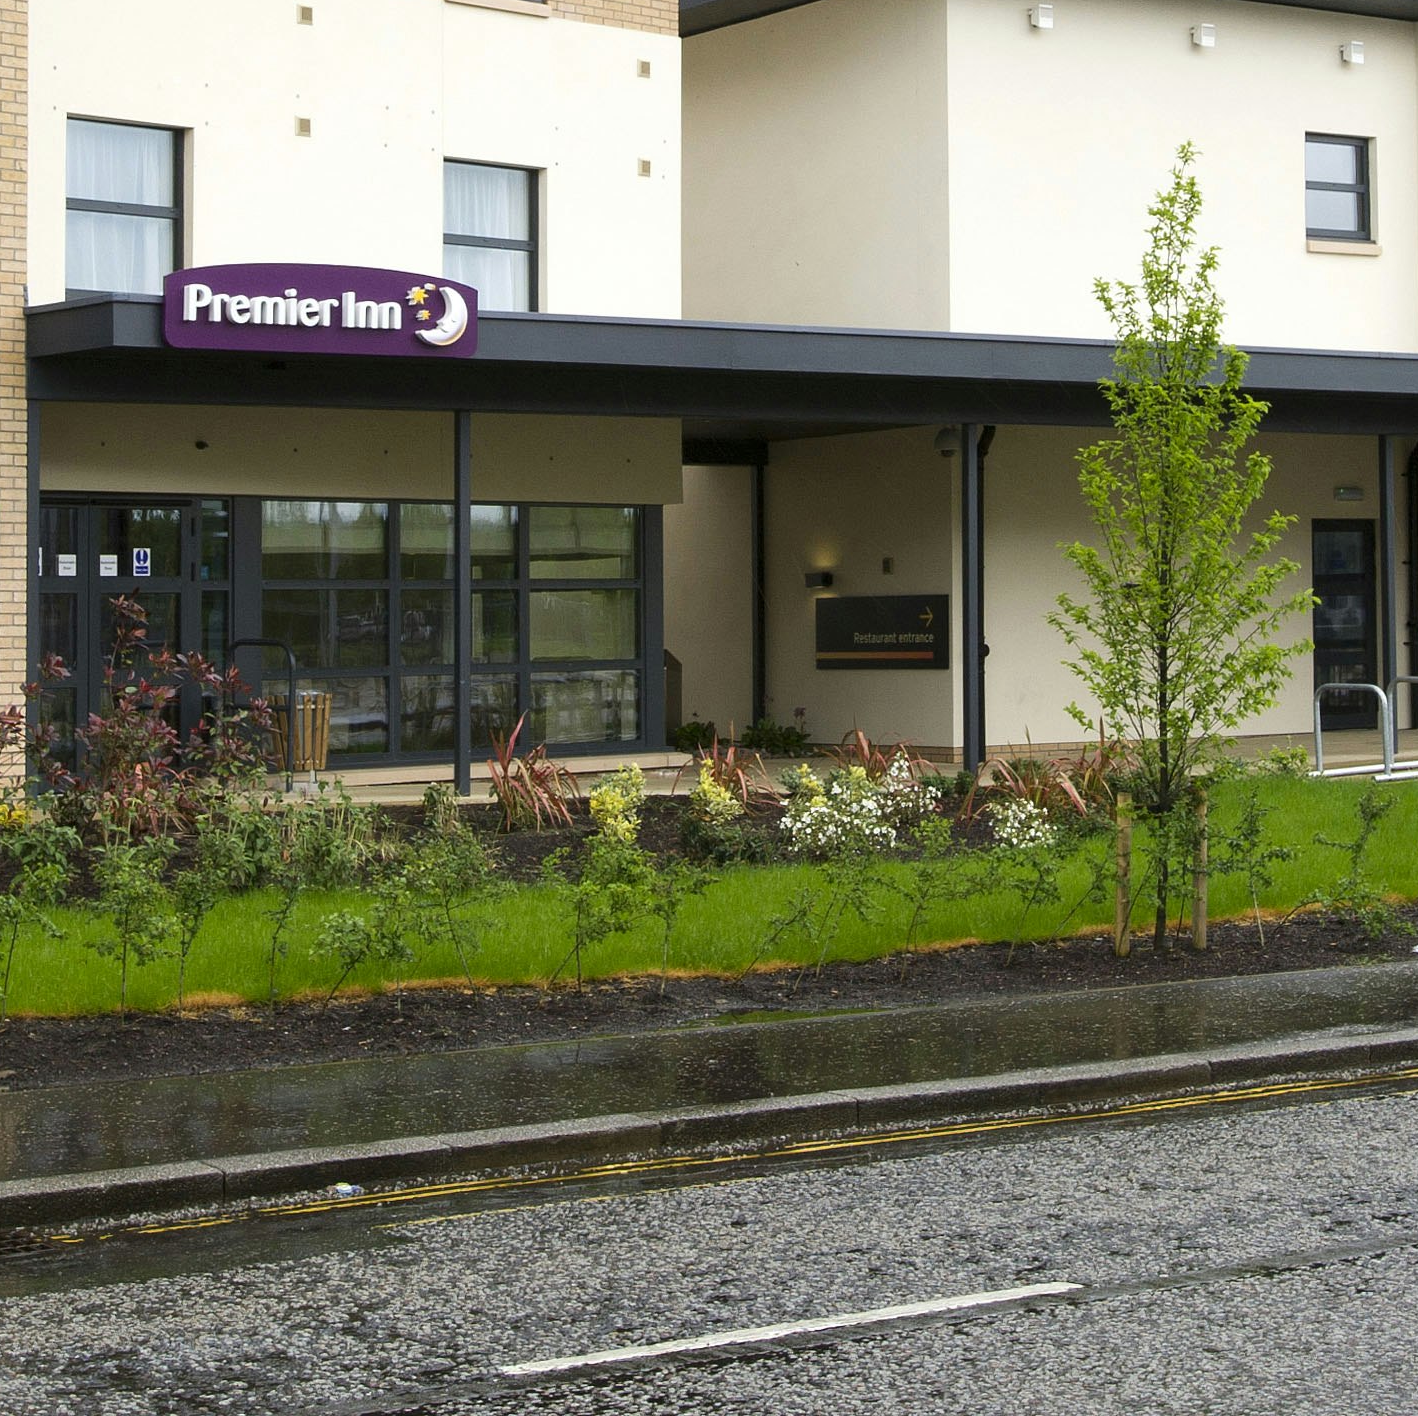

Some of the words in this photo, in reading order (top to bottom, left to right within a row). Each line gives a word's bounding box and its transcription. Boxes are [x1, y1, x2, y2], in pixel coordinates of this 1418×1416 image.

[183, 283, 339, 328] Premier
[341, 291, 402, 330] Inn
[854, 632, 897, 644] Restaurant
[898, 632, 934, 643] entrance
